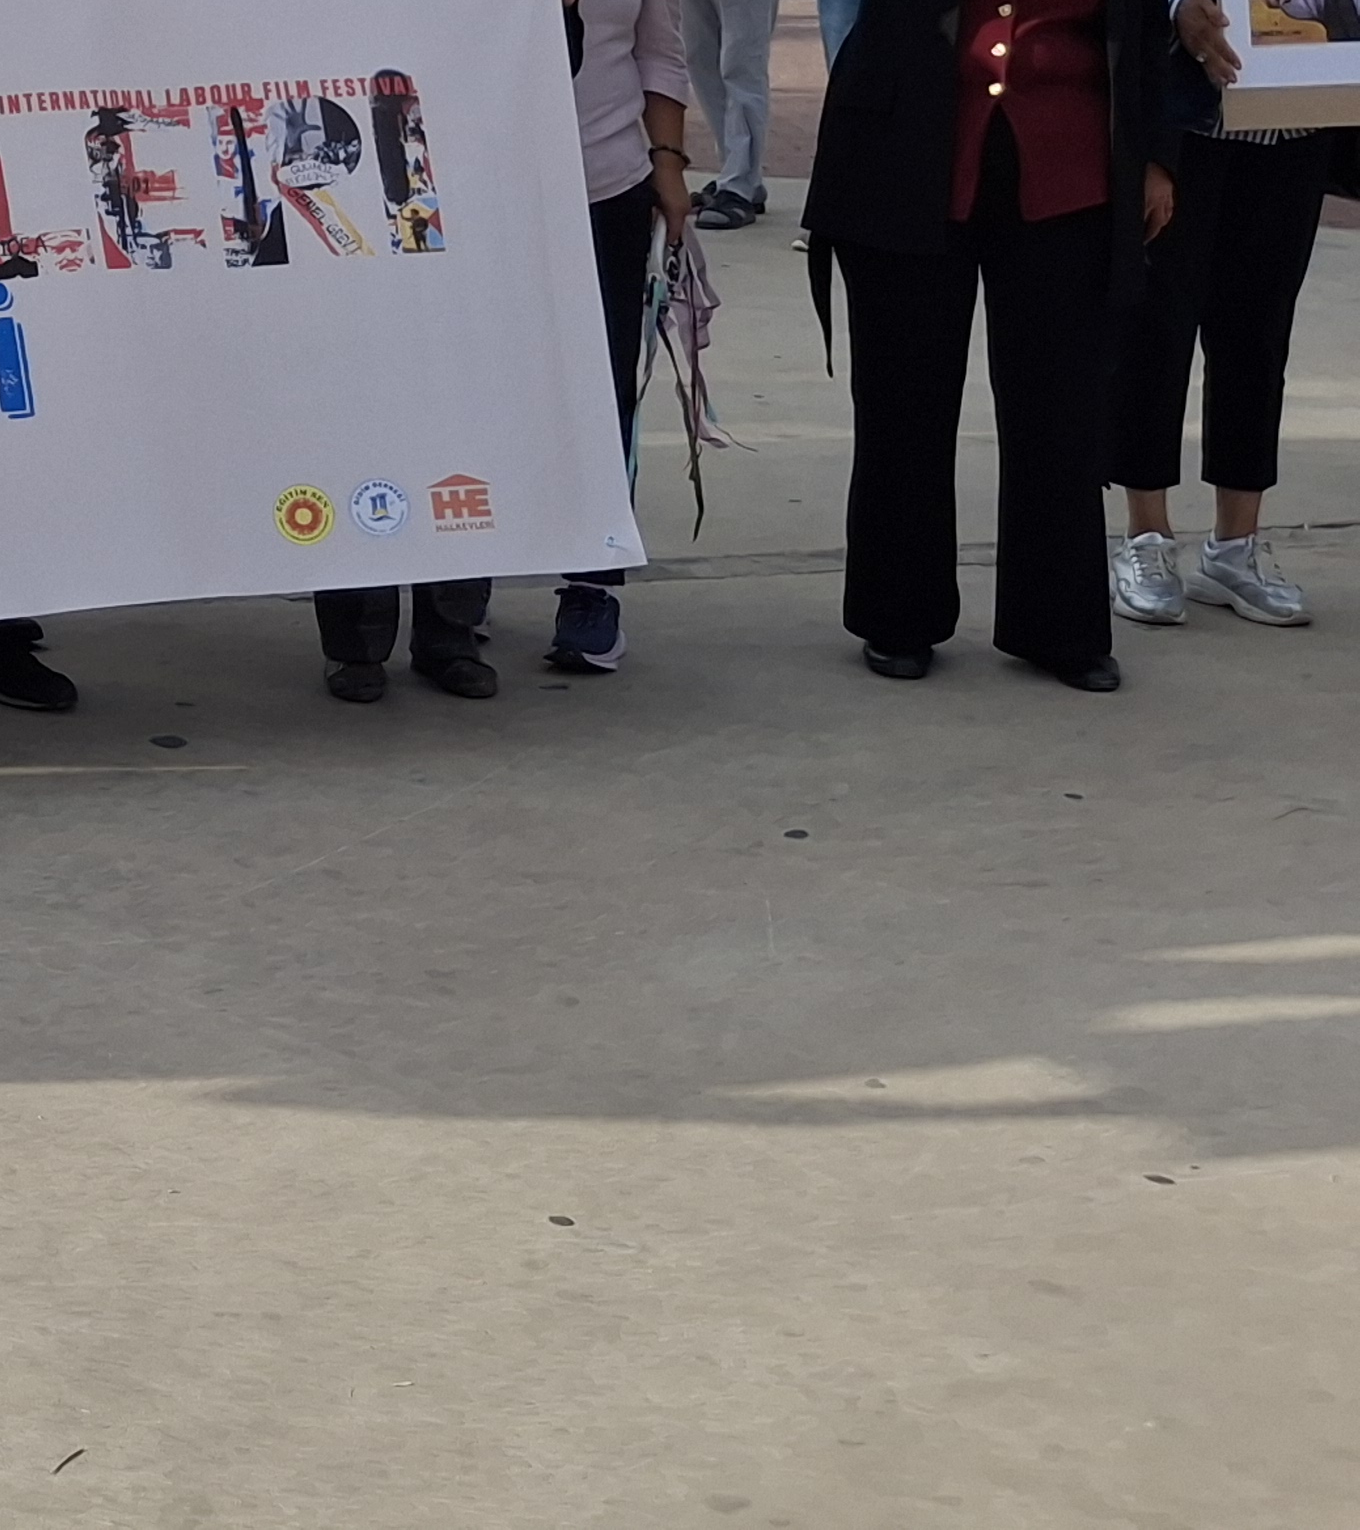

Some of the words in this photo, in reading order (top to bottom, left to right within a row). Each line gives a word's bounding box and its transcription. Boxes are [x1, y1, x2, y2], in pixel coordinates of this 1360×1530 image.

[165, 82, 253, 108] LABOUR
[262, 80, 311, 101] FILM
[320, 75, 418, 99] FESTIVAL
